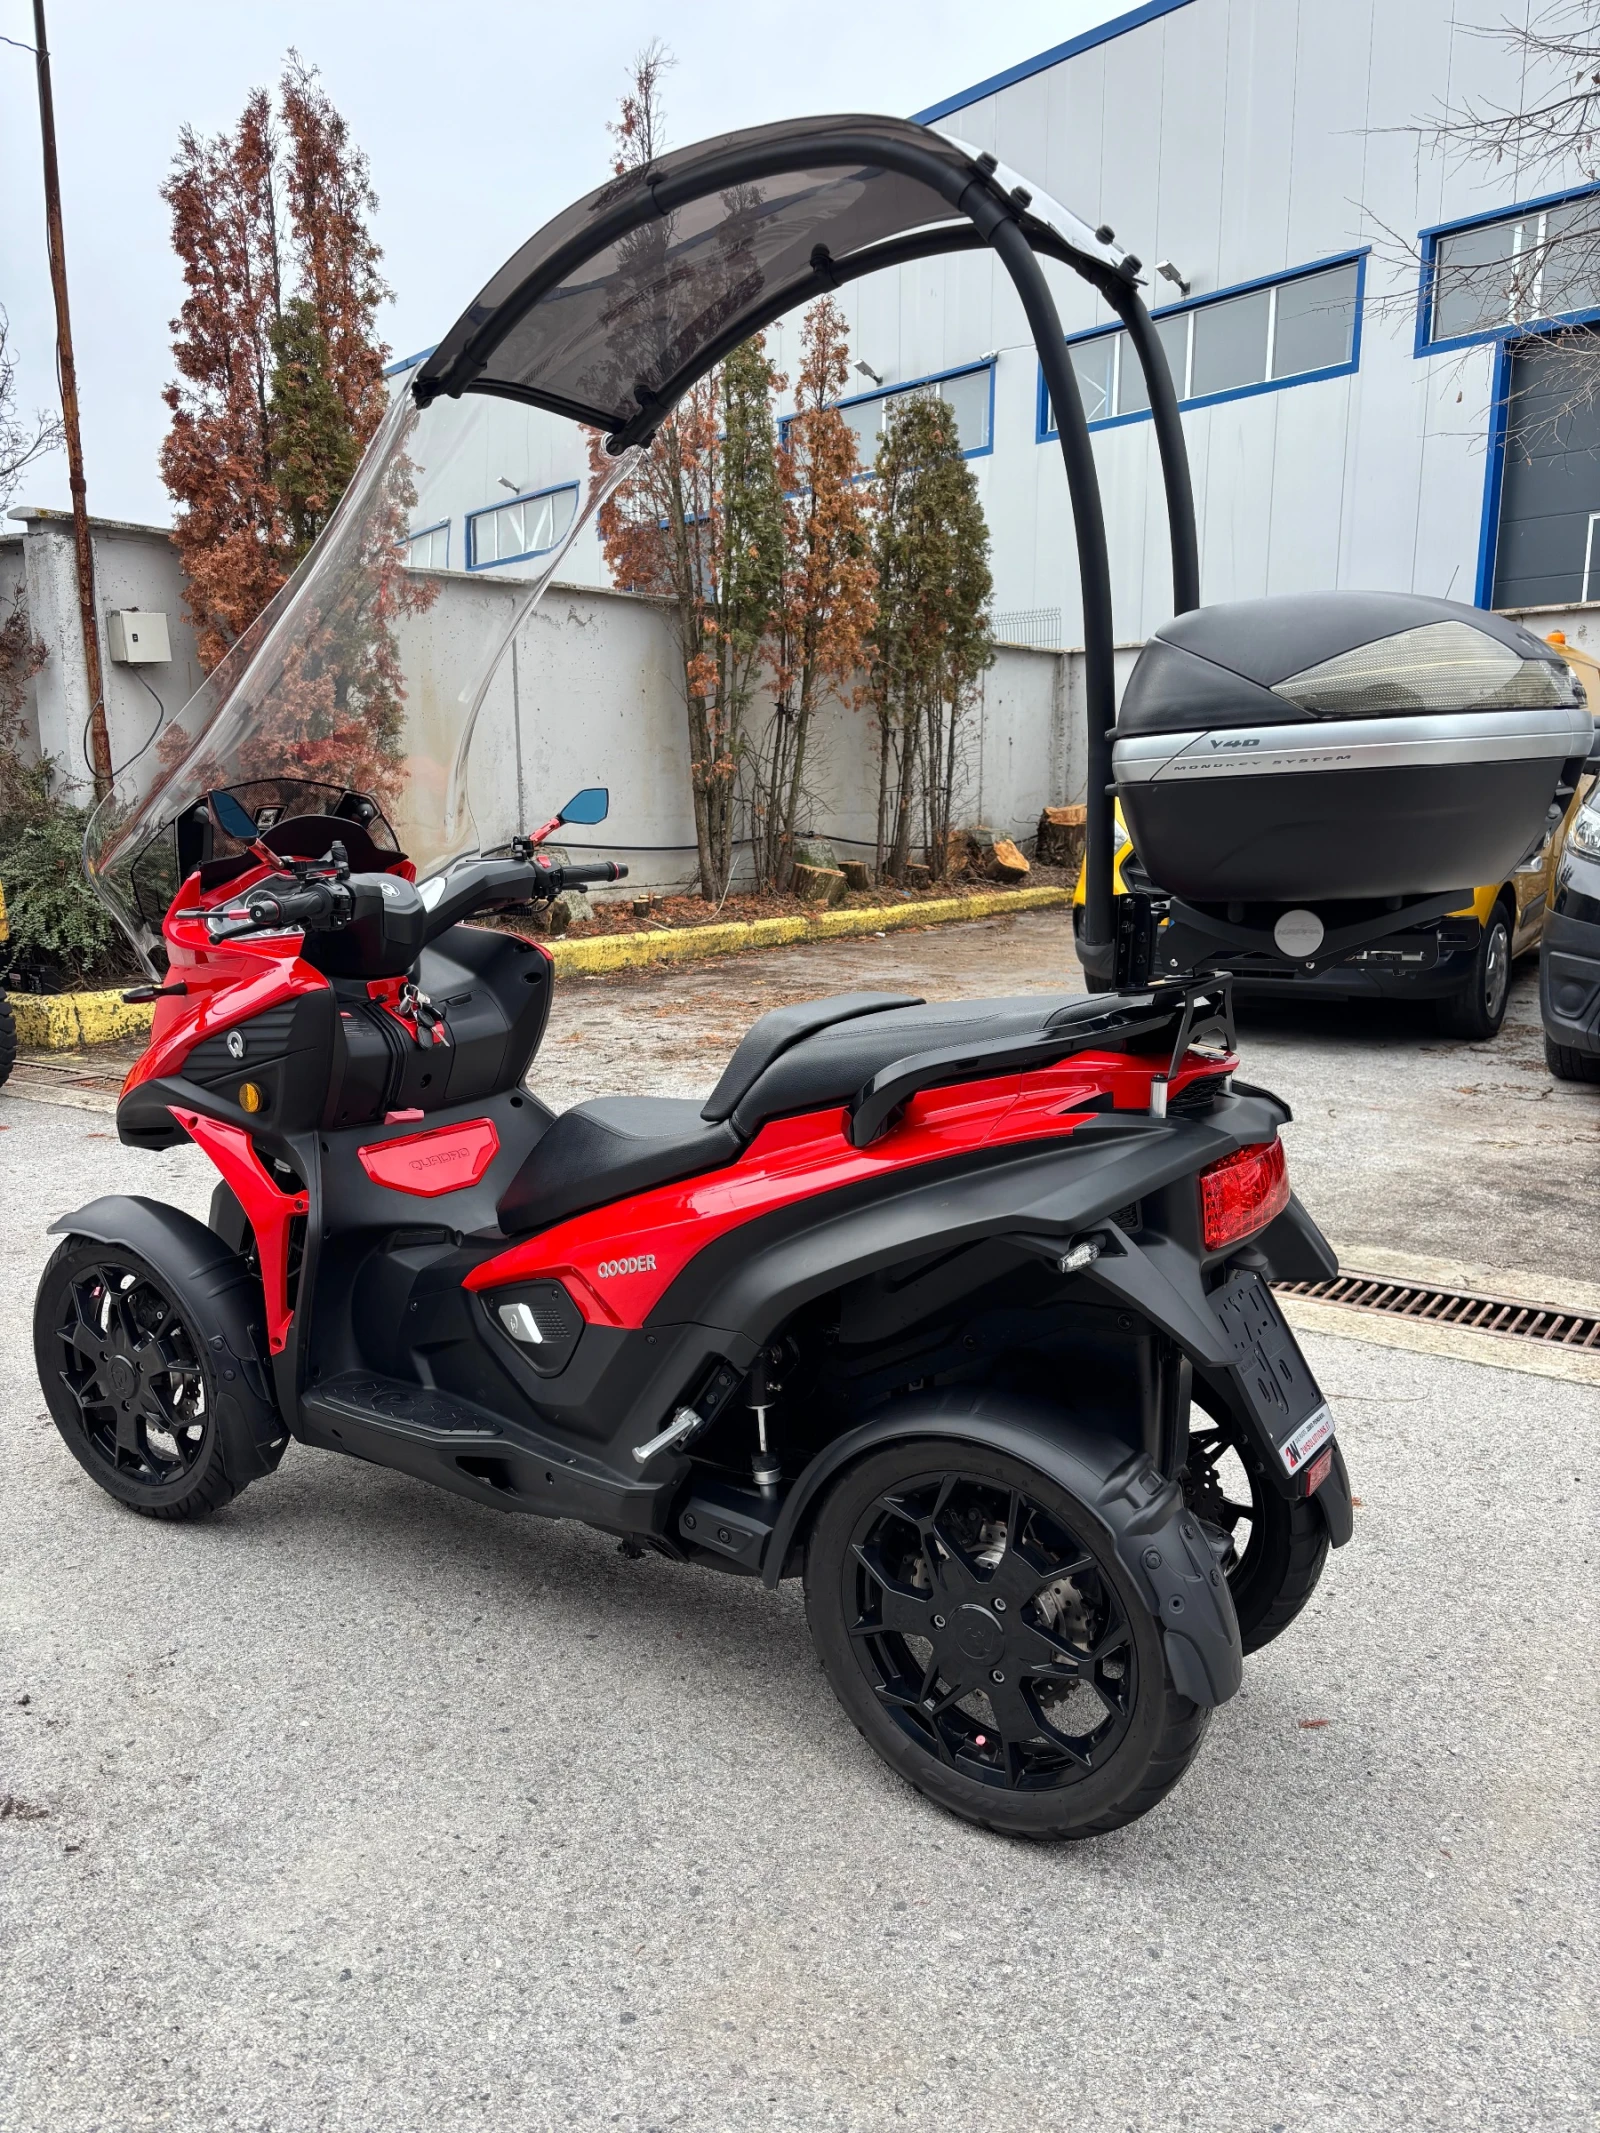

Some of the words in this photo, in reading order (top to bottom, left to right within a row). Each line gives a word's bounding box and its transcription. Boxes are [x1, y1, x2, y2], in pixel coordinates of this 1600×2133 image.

[1173, 760, 1262, 771] MONOKEY
[1272, 754, 1352, 766] SYSTEM
[408, 1147, 470, 1171] QUADRO
[597, 1253, 657, 1279] QOODER
[1285, 1440, 1302, 1468] 2W
